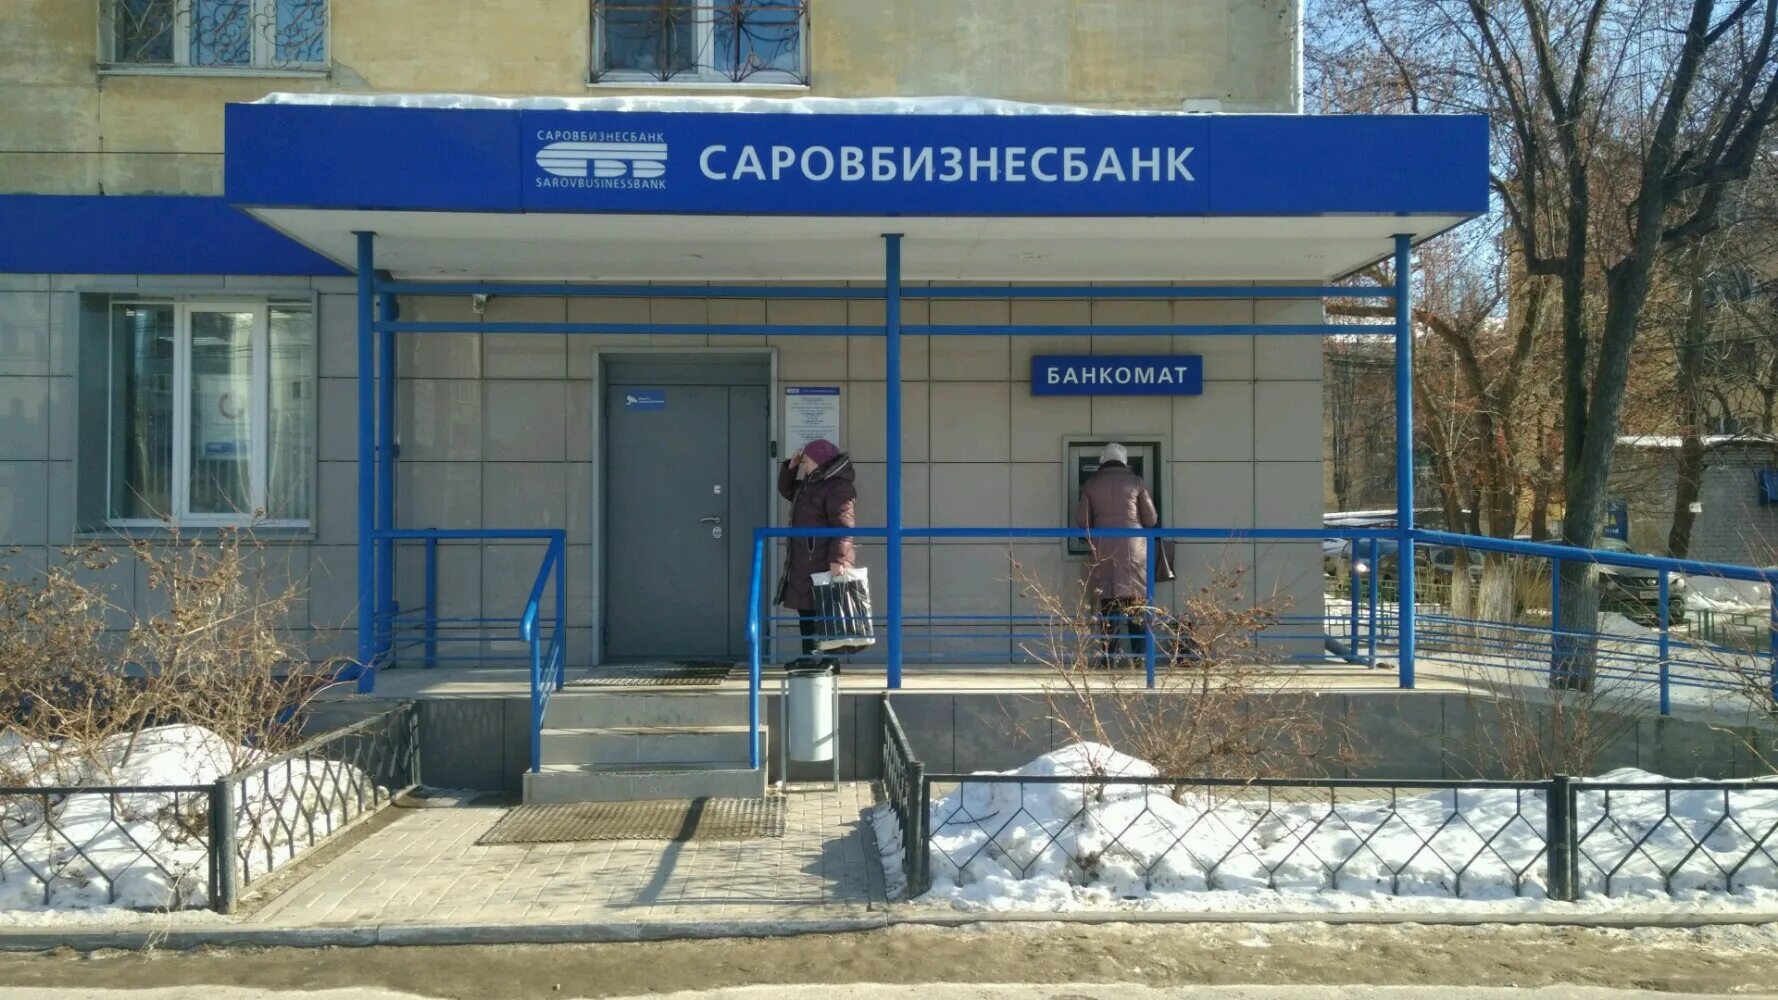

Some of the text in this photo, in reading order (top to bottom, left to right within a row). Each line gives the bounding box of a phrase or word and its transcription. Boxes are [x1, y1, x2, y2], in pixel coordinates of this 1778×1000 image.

[536, 130, 664, 142] САРОВБИЗНЕСБАНК
[699, 144, 1195, 182] САРОВБИЗНЕСБАНК
[536, 178, 666, 189] SAROVBUSINESSBANK
[1047, 367, 1188, 384] БАНКОМАТ
